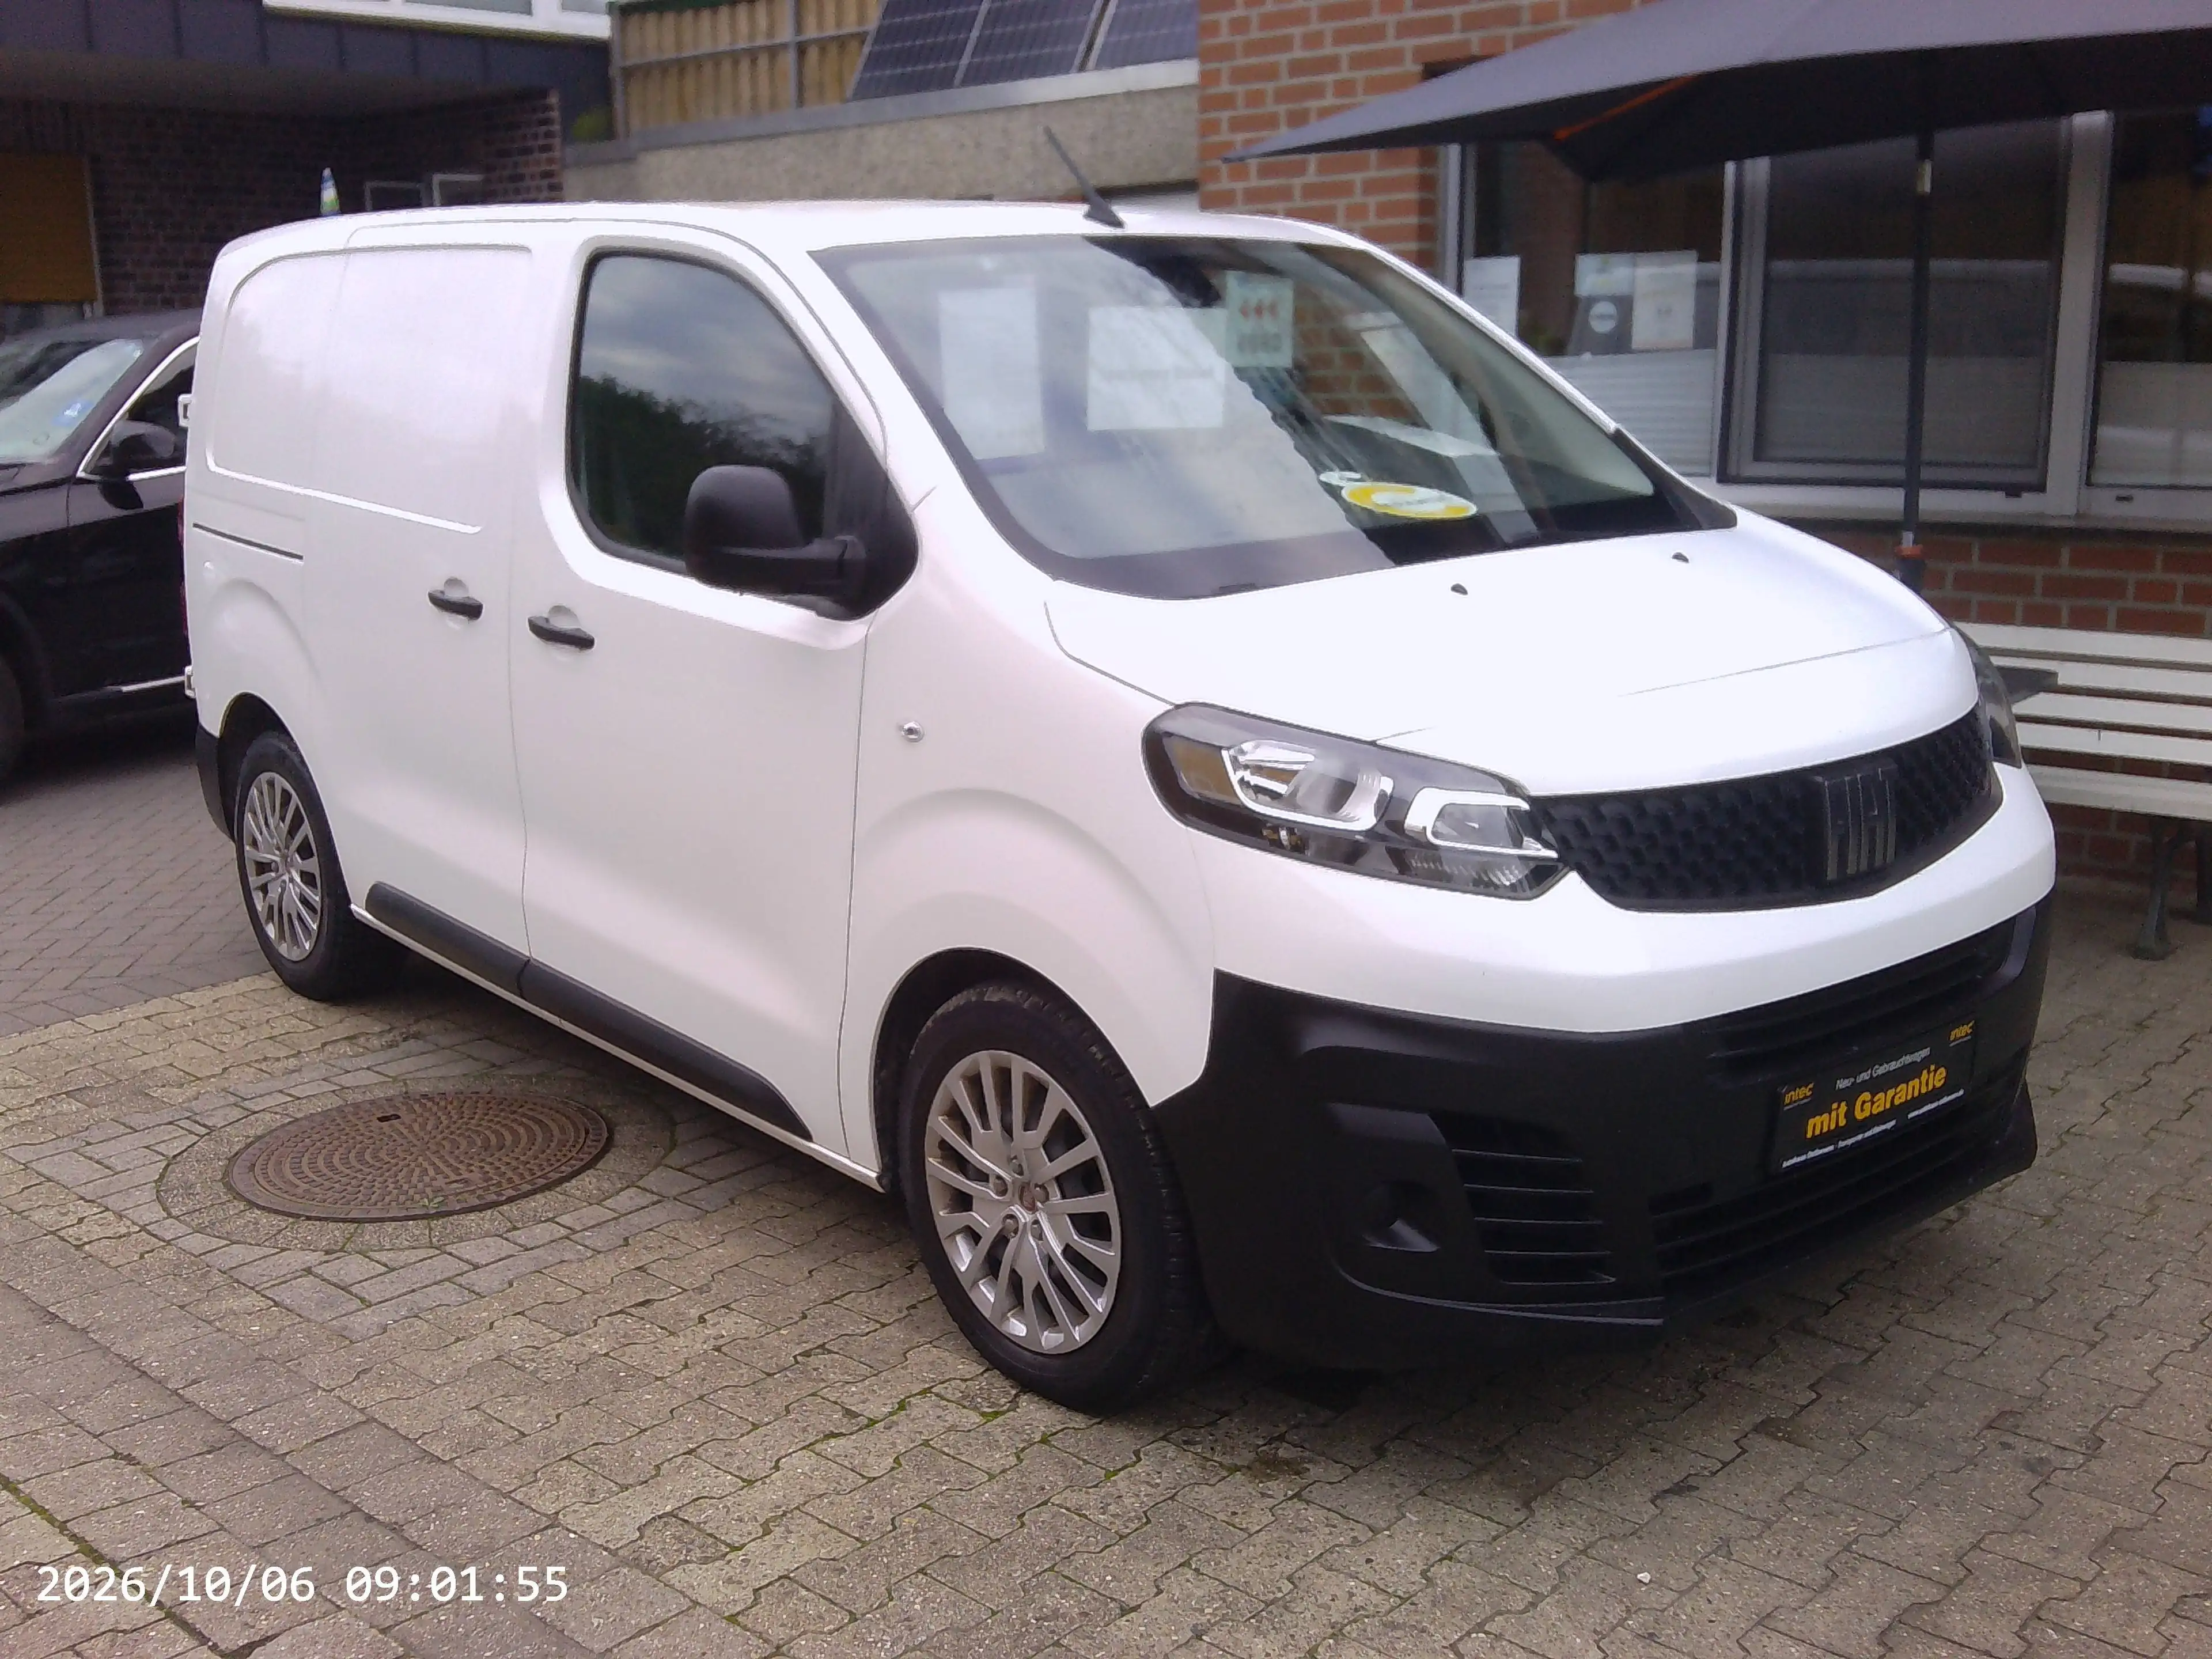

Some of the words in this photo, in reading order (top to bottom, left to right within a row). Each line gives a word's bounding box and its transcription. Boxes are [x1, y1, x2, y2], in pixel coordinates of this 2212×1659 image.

[1856, 1068, 1872, 1084] und
[1806, 1101, 1848, 1139] mit
[1854, 1063, 1948, 1120] Garantie
